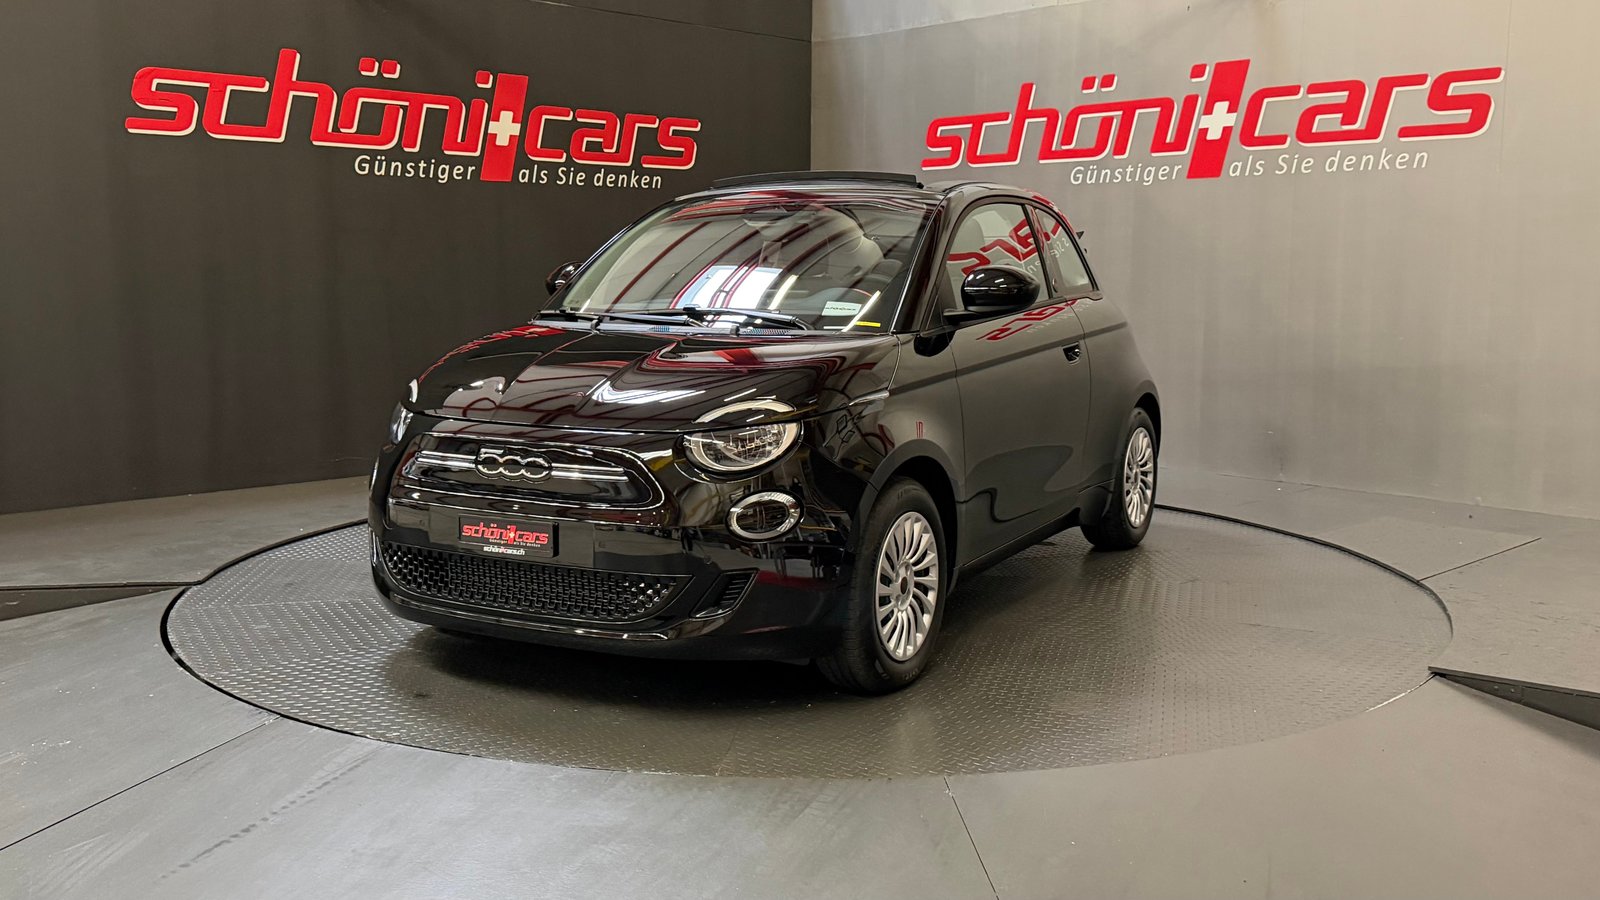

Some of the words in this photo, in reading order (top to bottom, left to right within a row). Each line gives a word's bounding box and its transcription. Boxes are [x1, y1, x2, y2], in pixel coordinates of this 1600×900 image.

[354, 154, 476, 183] Günstiger
[518, 164, 549, 184] als
[556, 166, 586, 186] Sie
[593, 168, 662, 189] denken
[1070, 162, 1183, 186] Günstiger
[1228, 156, 1265, 178] als
[1275, 153, 1314, 175] Sie
[1325, 148, 1429, 173] denken
[478, 448, 549, 478] 500
